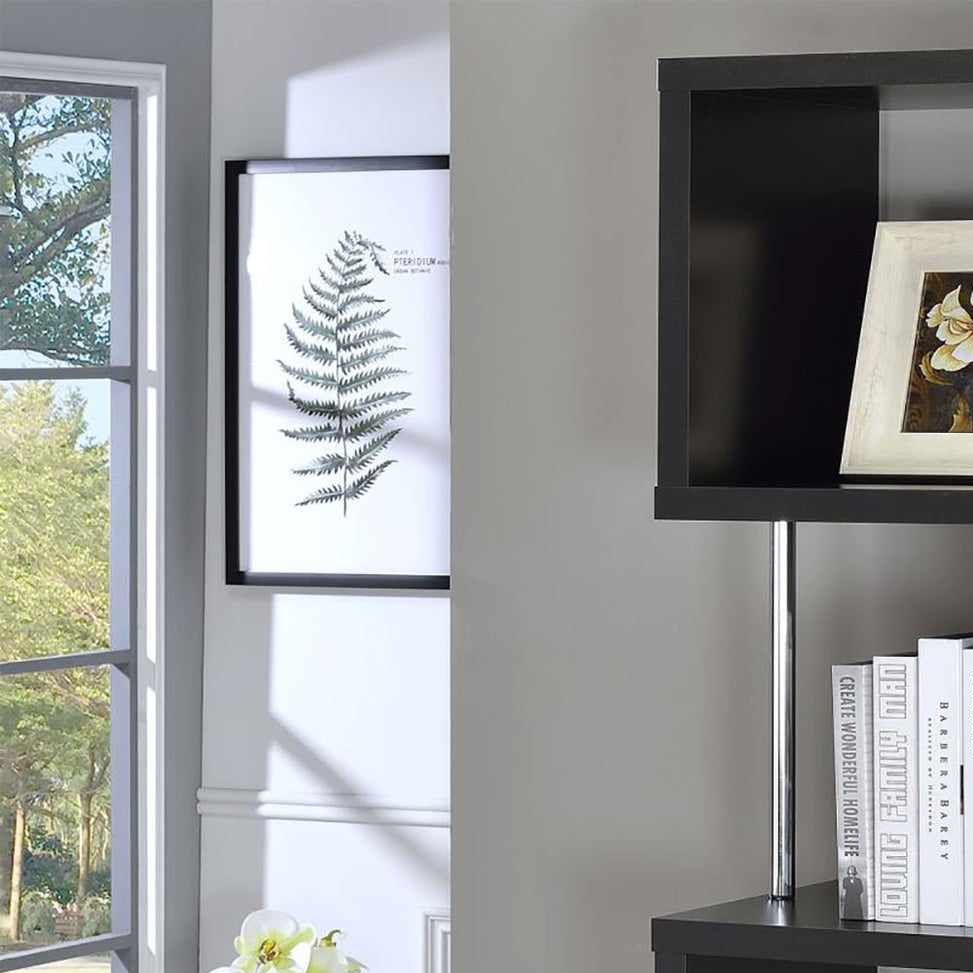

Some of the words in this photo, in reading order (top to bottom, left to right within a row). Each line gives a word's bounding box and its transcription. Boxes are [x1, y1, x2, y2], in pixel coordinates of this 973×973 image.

[393, 257, 437, 266] PTERIDIUM
[839, 676, 856, 718] CREATE
[879, 664, 907, 719] MAN
[841, 721, 859, 794] WONDERFUL
[939, 701, 949, 790] BARBERA
[879, 731, 908, 822] FAMILY
[843, 799, 860, 857] HOMELIFE
[940, 799, 950, 860] BAREY
